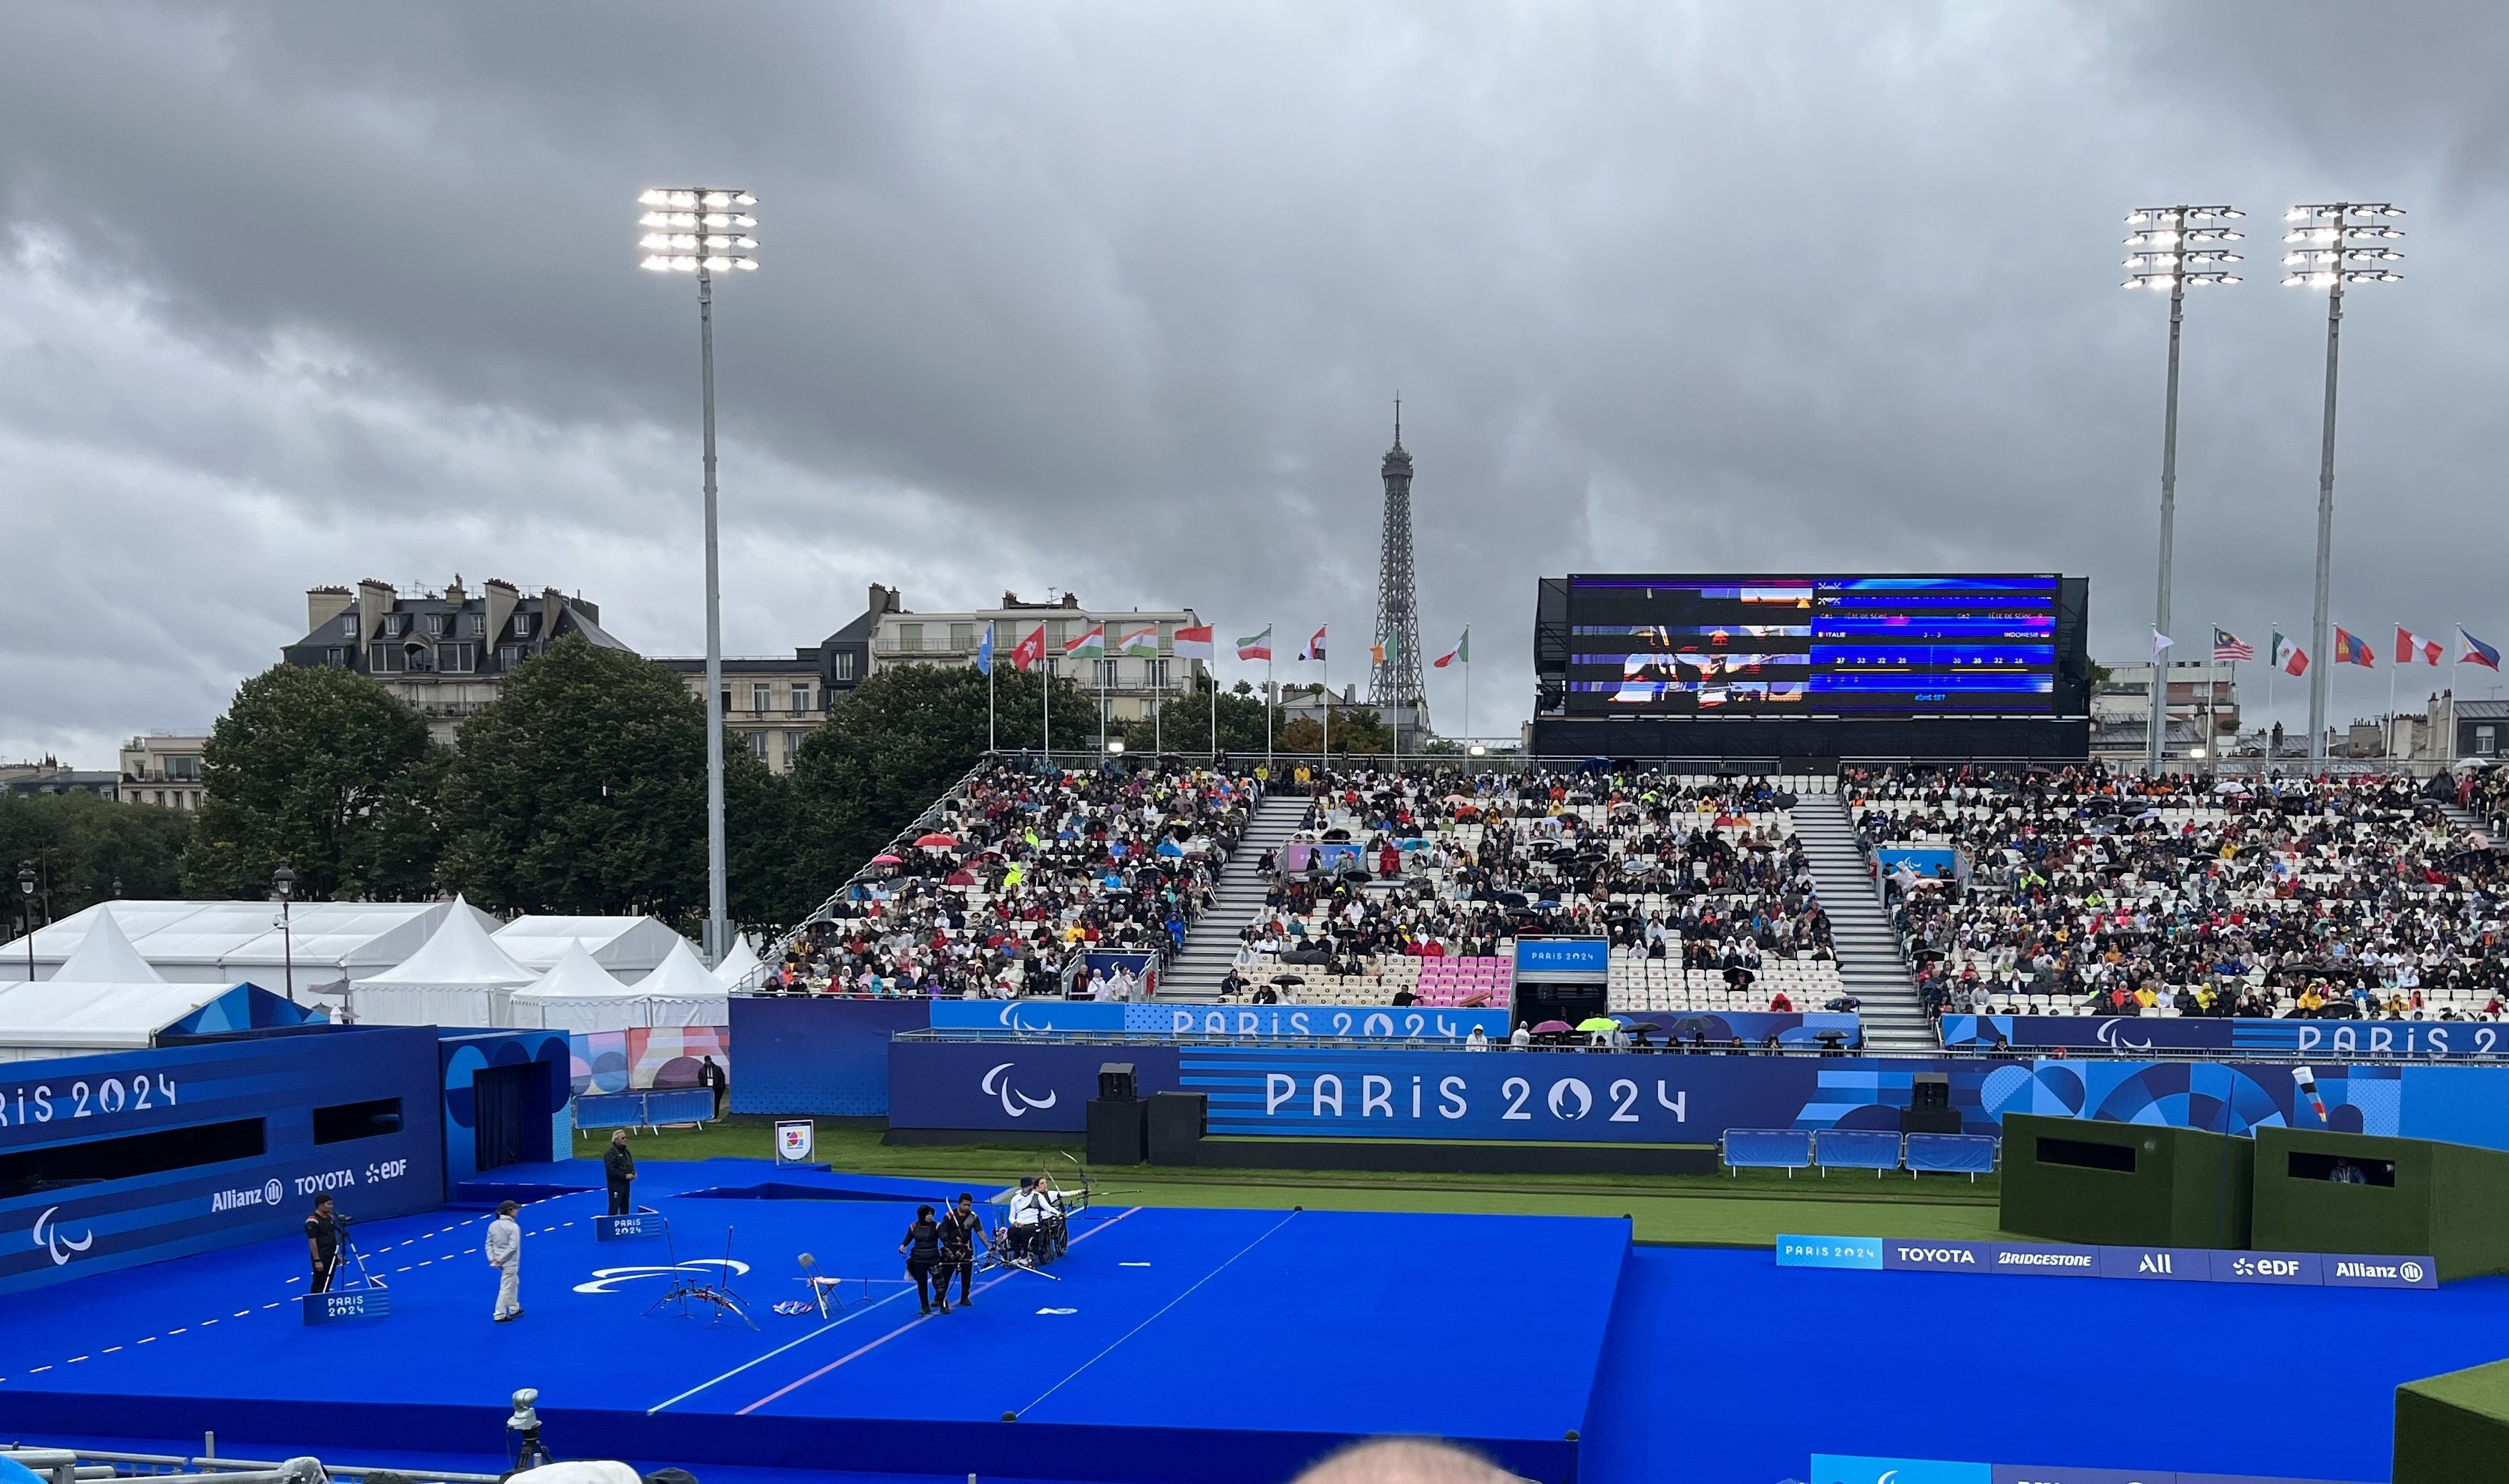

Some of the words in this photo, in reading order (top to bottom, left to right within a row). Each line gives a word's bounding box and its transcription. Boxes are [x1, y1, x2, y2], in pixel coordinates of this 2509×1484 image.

[1333, 1012, 1456, 1044] 2024
[72, 1073, 176, 1118] 2024
[1501, 1077, 1687, 1123] 2024
[212, 1188, 263, 1212] Allianz
[294, 1169, 355, 1195] TOYOTA
[615, 1226, 642, 1235] 2024
[1834, 1247, 1874, 1258] 2024
[1897, 1247, 1975, 1264] TOYOTA
[1997, 1251, 2092, 1267] BRIDGESTONE
[2336, 1262, 2397, 1279] Allianz
[328, 1306, 364, 1317] 2024
